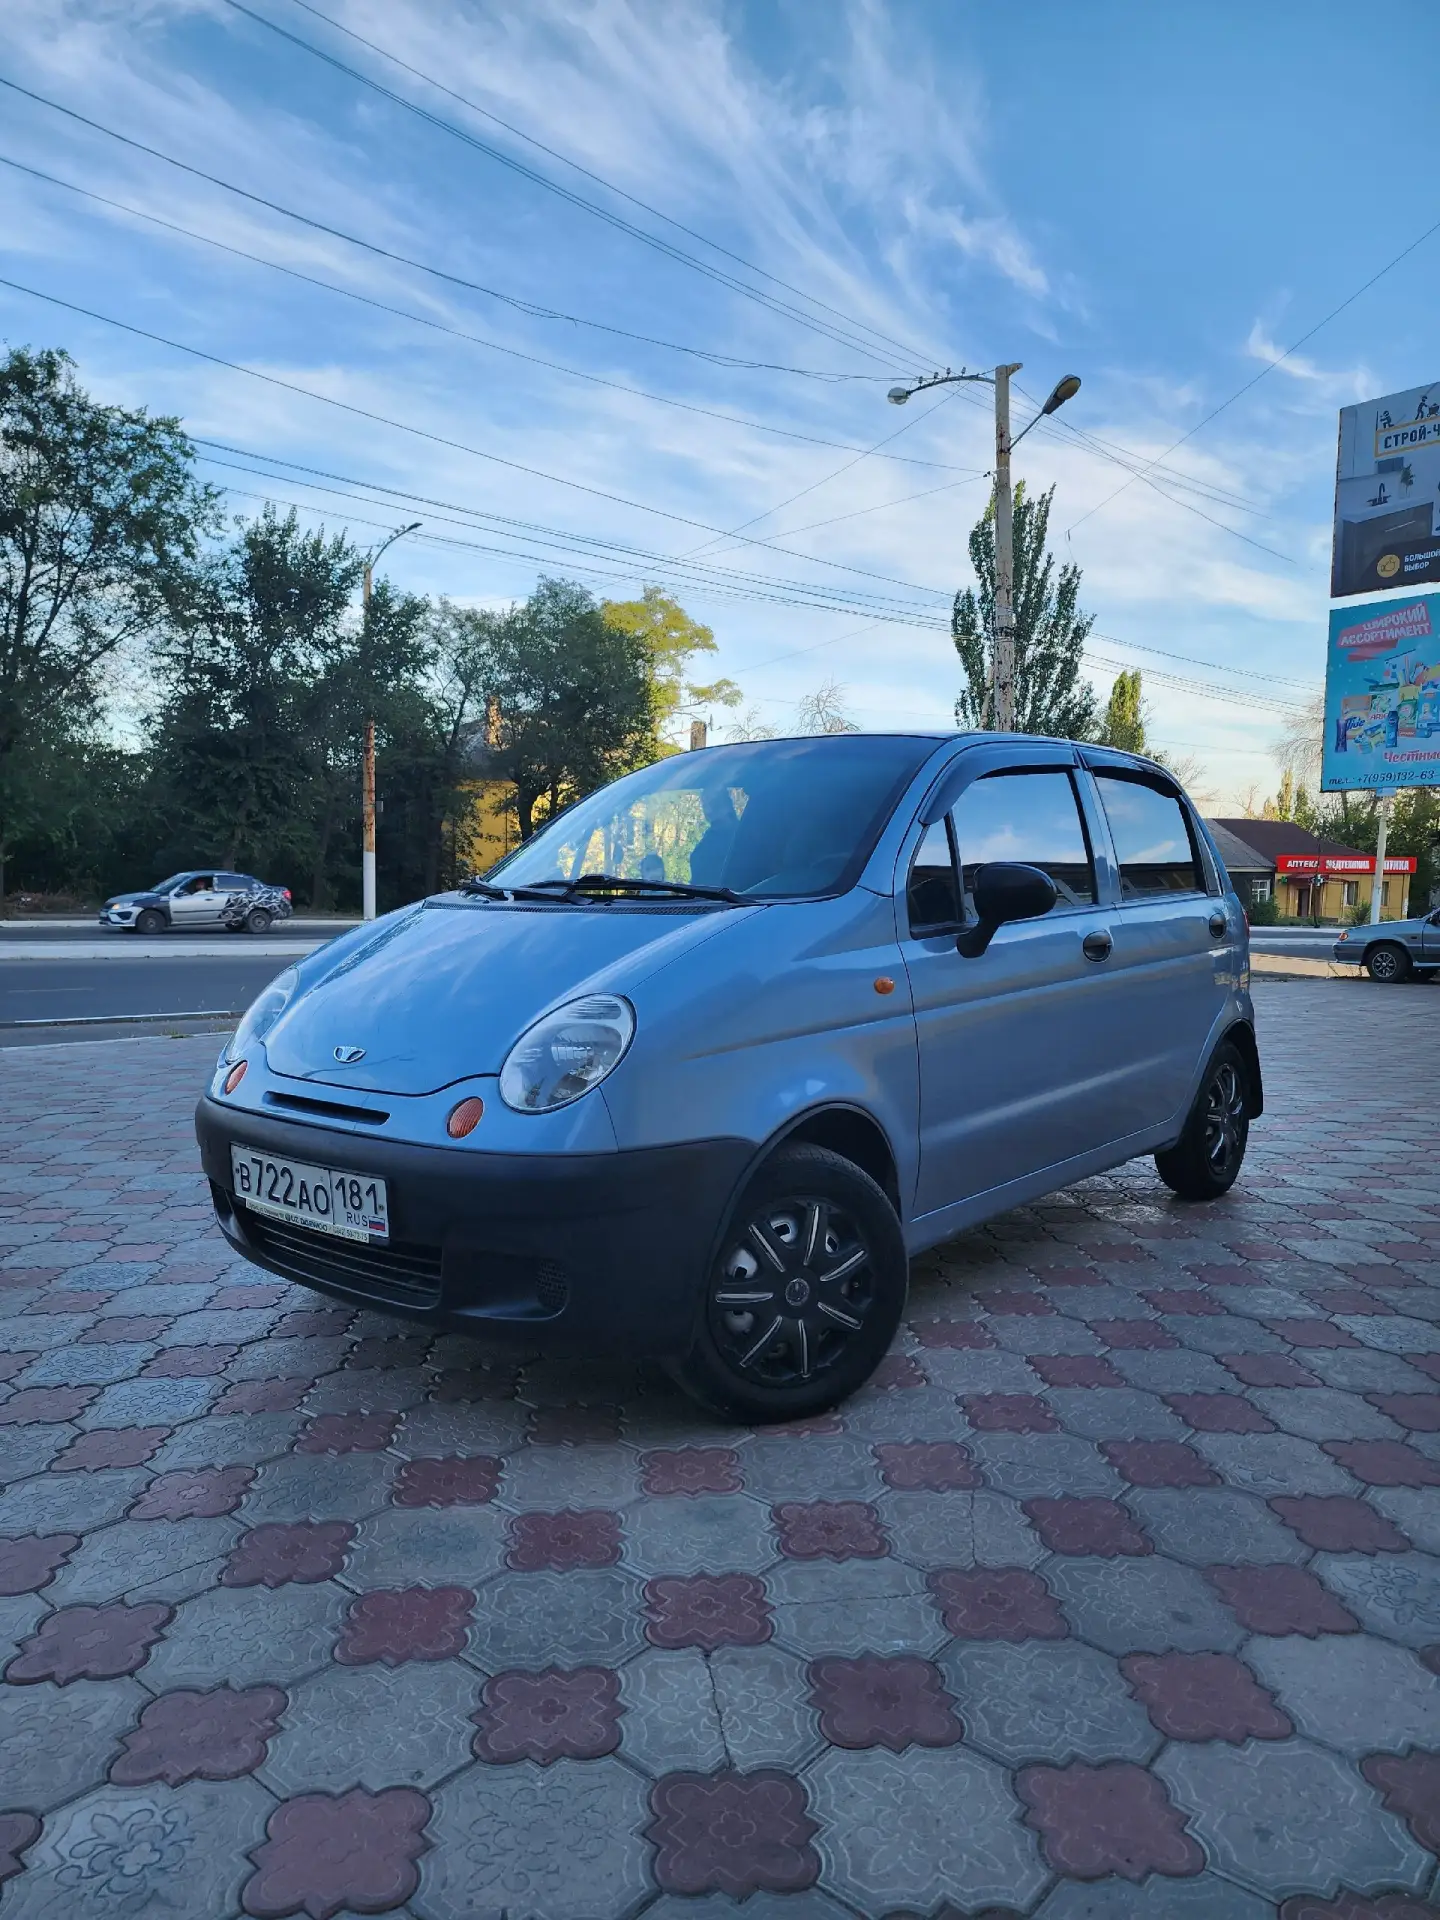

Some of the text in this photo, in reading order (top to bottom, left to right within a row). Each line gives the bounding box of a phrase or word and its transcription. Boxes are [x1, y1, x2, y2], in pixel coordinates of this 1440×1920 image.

[1404, 562, 1430, 572] ВЫБОР
[1363, 603, 1427, 631] ШИРОКИЙ
[1341, 623, 1429, 646] АССОРТИМЕНТ
[1286, 860, 1319, 868] АПТЕКА
[1377, 860, 1409, 870] ПТИКА
[335, 1176, 378, 1215] 181
[346, 1212, 369, 1227] RUS
